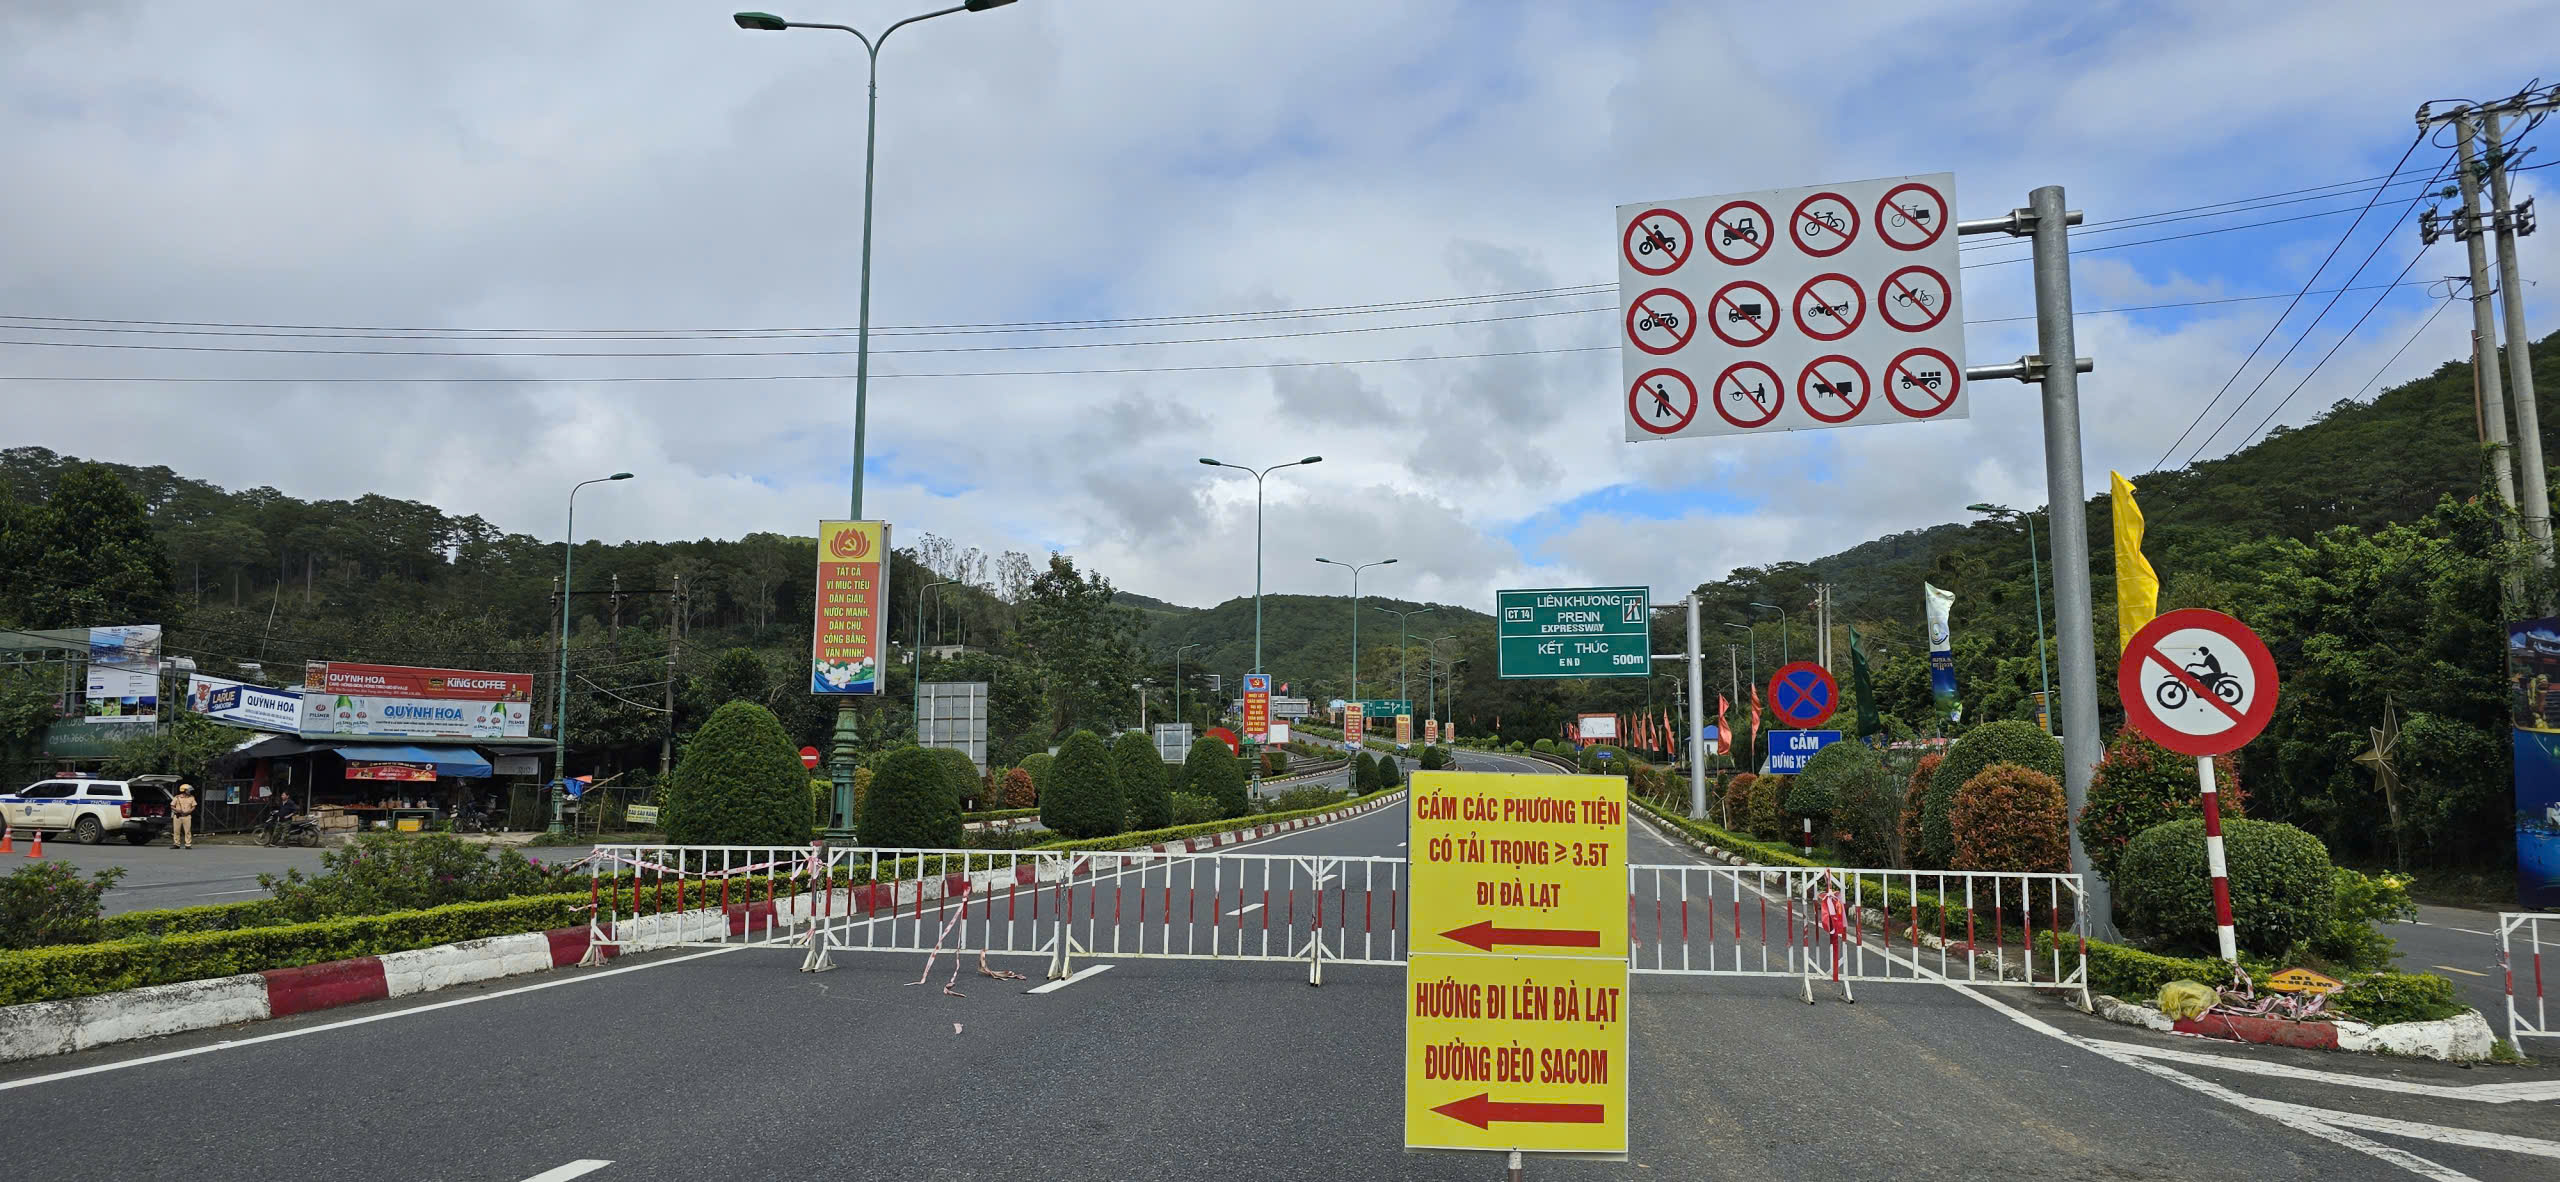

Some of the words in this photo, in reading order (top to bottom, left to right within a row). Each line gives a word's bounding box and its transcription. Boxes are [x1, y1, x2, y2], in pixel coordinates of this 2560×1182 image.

[836, 564, 849, 576] TẤT
[851, 564, 861, 576] CẢ
[826, 579, 834, 590] VÌ
[854, 579, 870, 590] TIÊU
[829, 592, 845, 603] DÂN
[846, 592, 866, 604] GIÀU,
[1537, 594, 1563, 608] LIÊN
[1564, 595, 1621, 607] KHƯƠNG
[824, 606, 844, 617] NƯỚC
[1508, 610, 1518, 619] CT
[1520, 609, 1530, 619] 14
[1558, 612, 1600, 623] PRENN
[829, 619, 844, 630] DÂN
[1541, 623, 1604, 633] EXPRESSWAY
[823, 632, 844, 644] CÔNG
[845, 631, 867, 645] BẰNG,
[825, 646, 841, 658] VĂN
[842, 648, 865, 658] MINH!
[1538, 640, 1564, 655] KẾT
[1574, 640, 1609, 654] THÚC
[1560, 657, 1580, 667] END
[1613, 654, 1644, 665] 500m
[364, 676, 386, 684] HOA
[447, 677, 471, 688] KING
[471, 679, 506, 690] COFFEE
[213, 690, 236, 704] LARUE
[247, 695, 275, 710] QUỲNH
[277, 701, 295, 713] HOA
[434, 706, 464, 721] HOA
[1790, 730, 1819, 750] CẤM
[1771, 751, 1795, 769] DỪNG
[1795, 754, 1807, 768] XE
[1417, 788, 1457, 821] CẤM
[1463, 792, 1498, 822] CÁC
[1503, 796, 1576, 824] PHƯƠNG
[1581, 796, 1621, 830] TIỆN
[1429, 833, 1453, 862] CÓ
[1458, 831, 1485, 863] TẢI
[1490, 840, 1549, 870] TRỌNG
[1572, 842, 1609, 867] 3.5T
[1477, 881, 1495, 906] ĐI
[1500, 878, 1525, 907] ĐÀ
[1529, 883, 1561, 912] LẠT
[1416, 976, 1481, 1019] HƯỚNG
[1487, 984, 1506, 1020] ĐI
[1512, 978, 1548, 1021] LÊN
[1553, 980, 1580, 1022] ĐÀ
[1585, 987, 1620, 1031] LẠT
[1425, 1036, 1491, 1081] ĐƯỜNG
[1497, 1040, 1534, 1083] ĐÈO
[1541, 1048, 1608, 1085] SACOM
